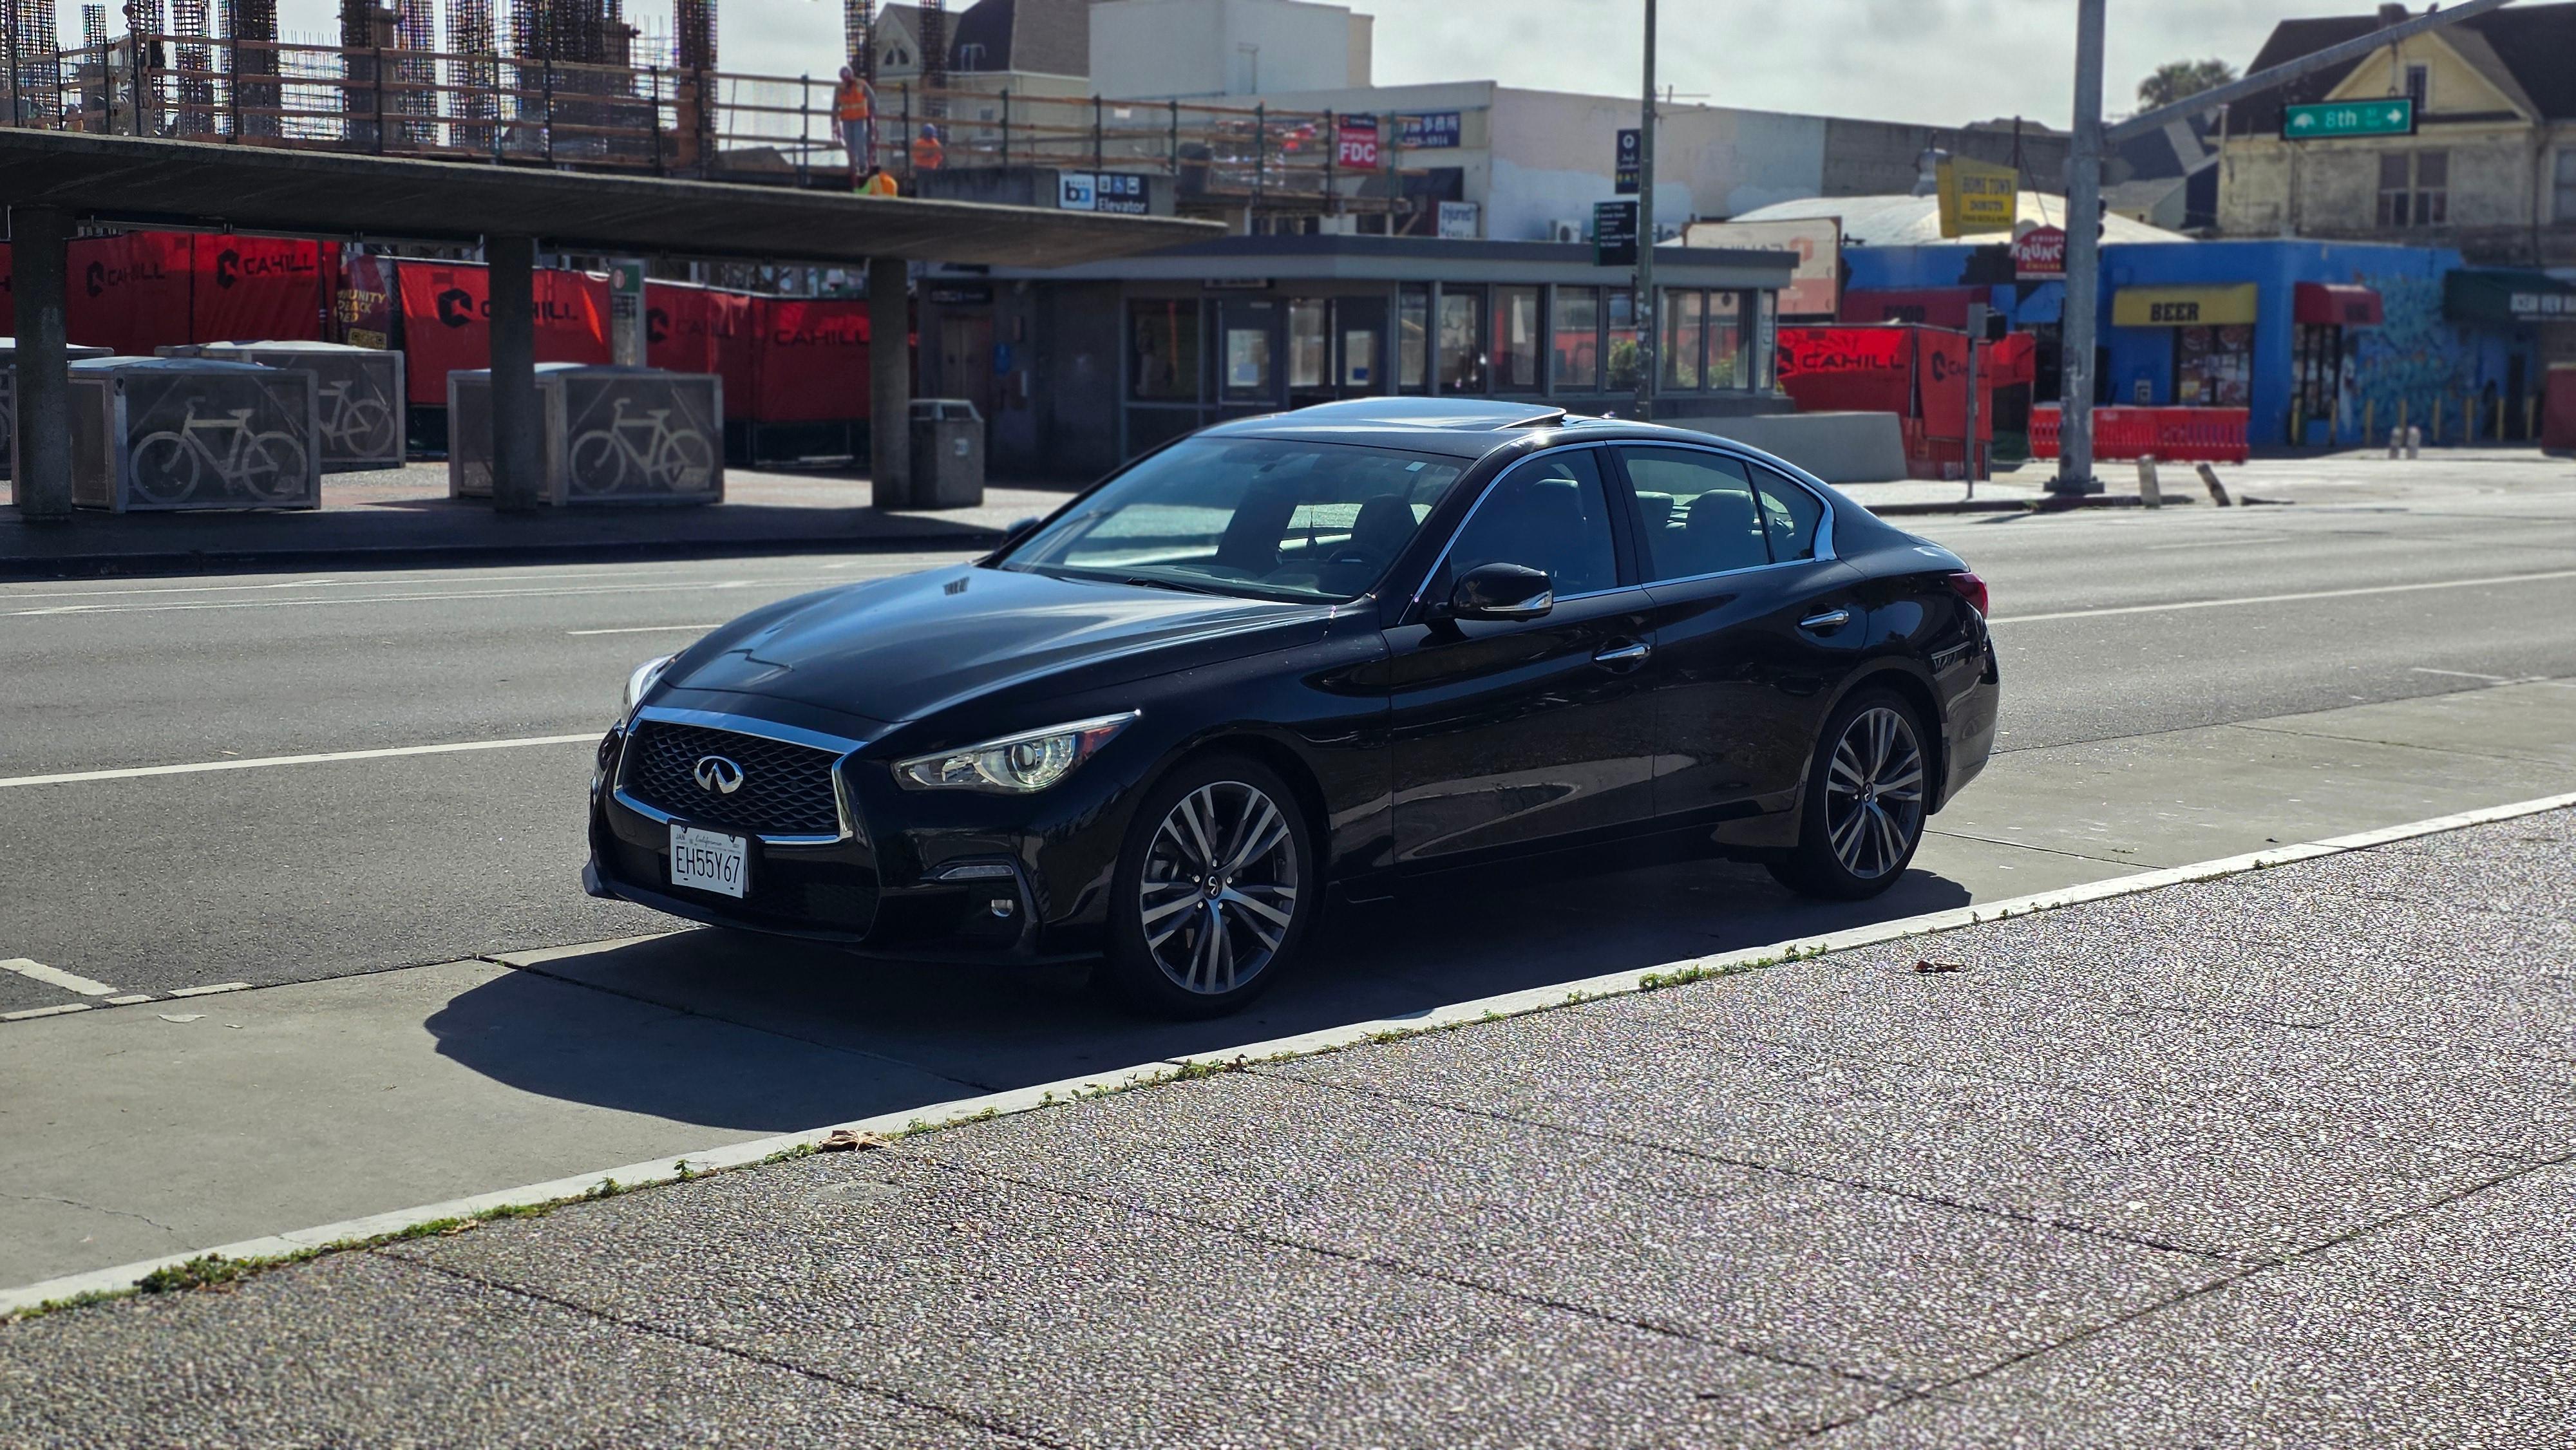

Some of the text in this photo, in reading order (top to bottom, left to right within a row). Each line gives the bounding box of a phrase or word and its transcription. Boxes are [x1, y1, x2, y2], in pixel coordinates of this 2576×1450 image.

[2325, 109, 2358, 128] 8th
[1340, 142, 1376, 162] FDC
[1097, 197, 1146, 213] Elevator
[2009, 243, 2063, 262] KRUNC
[244, 252, 316, 276] CAHILL
[108, 262, 166, 287] CAHILL
[2150, 303, 2200, 321] BEER
[775, 329, 870, 346] CAHILL
[1803, 353, 1906, 370] CAHILL
[695, 834, 723, 848] California
[676, 845, 741, 884] EH55Y67
